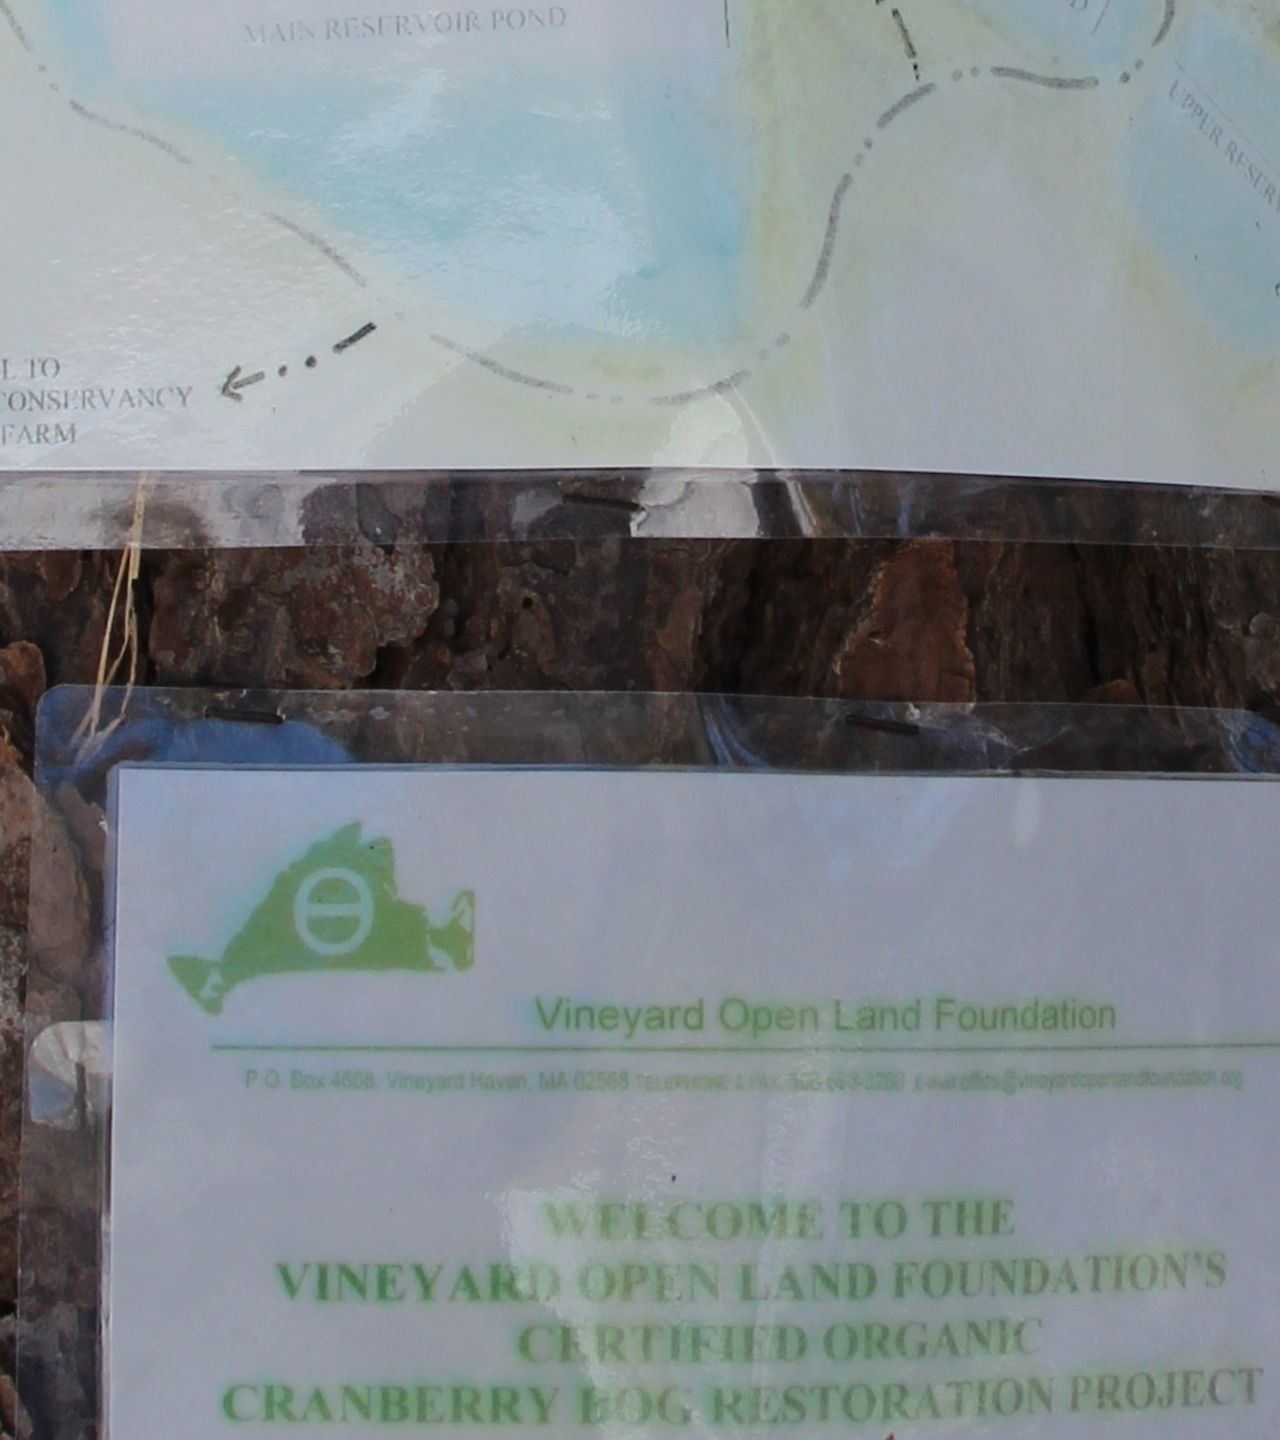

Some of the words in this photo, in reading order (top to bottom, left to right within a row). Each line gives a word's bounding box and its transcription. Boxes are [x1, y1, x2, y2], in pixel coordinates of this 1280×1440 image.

[243, 20, 315, 45] MAIN
[326, 9, 480, 40] RESERVOIR
[490, 7, 567, 30] POND
[1168, 80, 1223, 146] UPPER
[26, 357, 61, 378] TO
[2, 423, 76, 446] FARM
[535, 997, 703, 1038] Vineyard
[719, 998, 818, 1038] Open
[834, 996, 921, 1032] Land
[935, 996, 1117, 1032] Foundation
[537, 1201, 823, 1244] WELCOME
[840, 1201, 906, 1241] TO
[920, 1198, 1016, 1237] THE
[274, 1262, 561, 1305] VINEYARD
[578, 1262, 720, 1302] OPEN
[738, 1260, 877, 1302] LAND
[893, 1250, 1227, 1300] FOUNDATION'S
[519, 1324, 807, 1367] CERTIFIED
[823, 1319, 1044, 1364] ORGANIC
[222, 1383, 561, 1426] CRANBERRY
[578, 1384, 692, 1427] BOG
[711, 1377, 1055, 1427] RESTORATION
[1069, 1366, 1265, 1414] PROJECT
